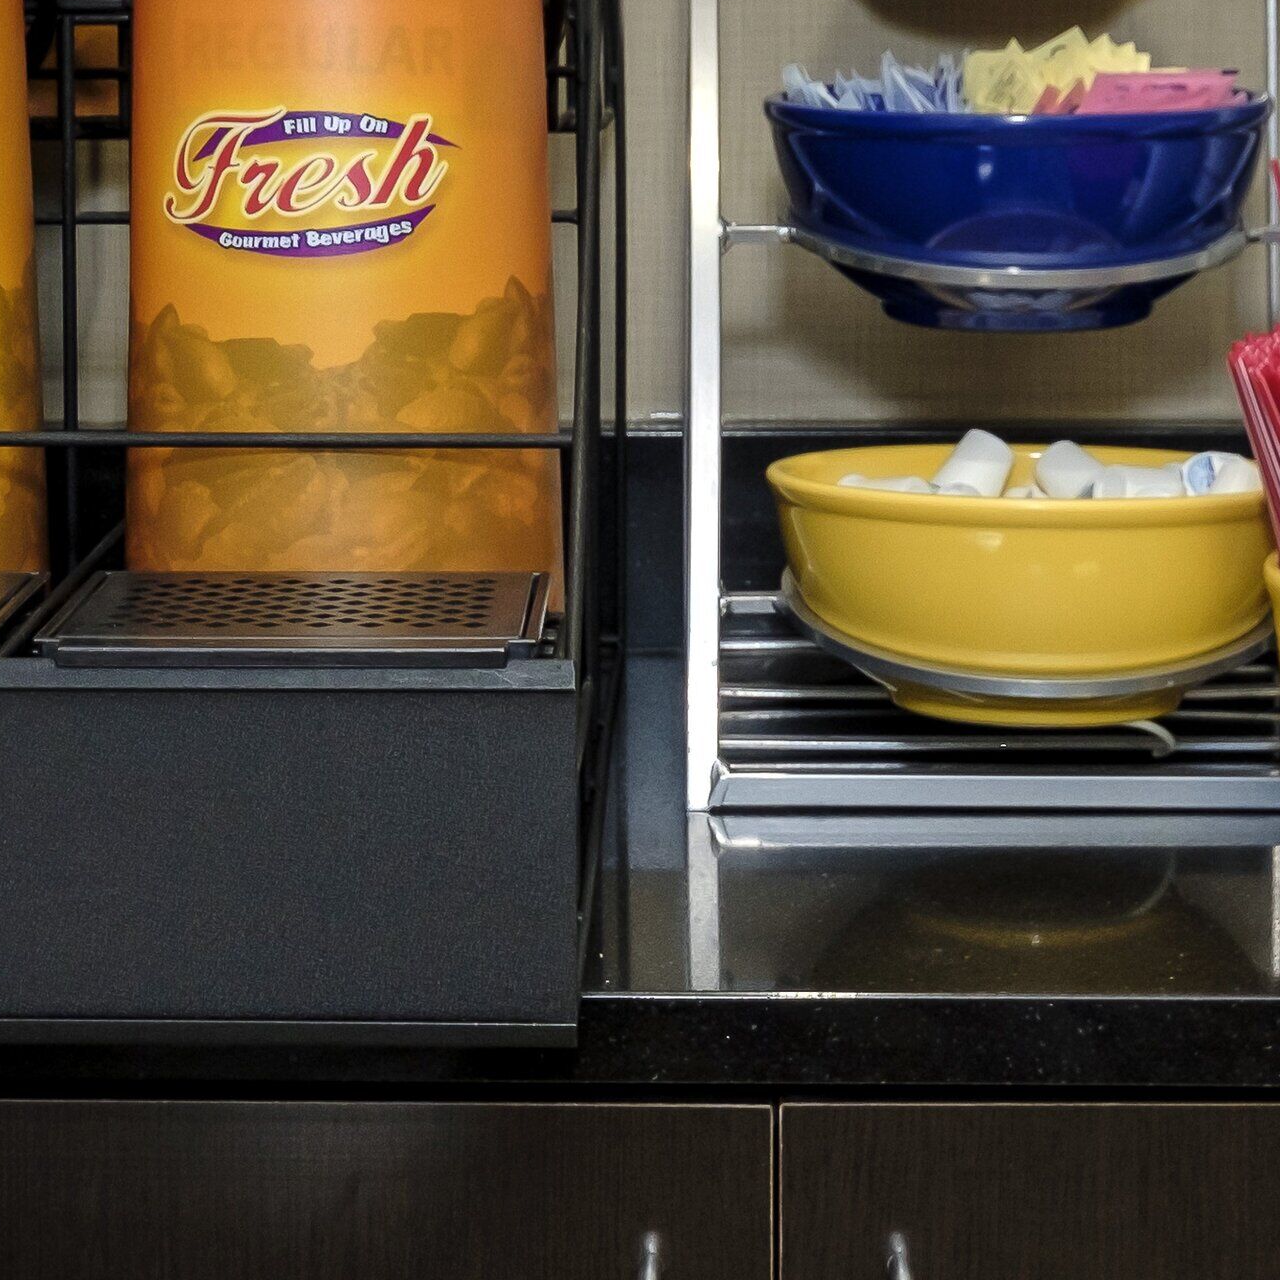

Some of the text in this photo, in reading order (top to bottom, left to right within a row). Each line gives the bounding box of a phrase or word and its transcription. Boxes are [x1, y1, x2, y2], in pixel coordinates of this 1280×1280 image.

[282, 113, 389, 136] Fill Up On
[165, 106, 448, 223] Fresh
[218, 219, 413, 250] Gourmet Beverages
